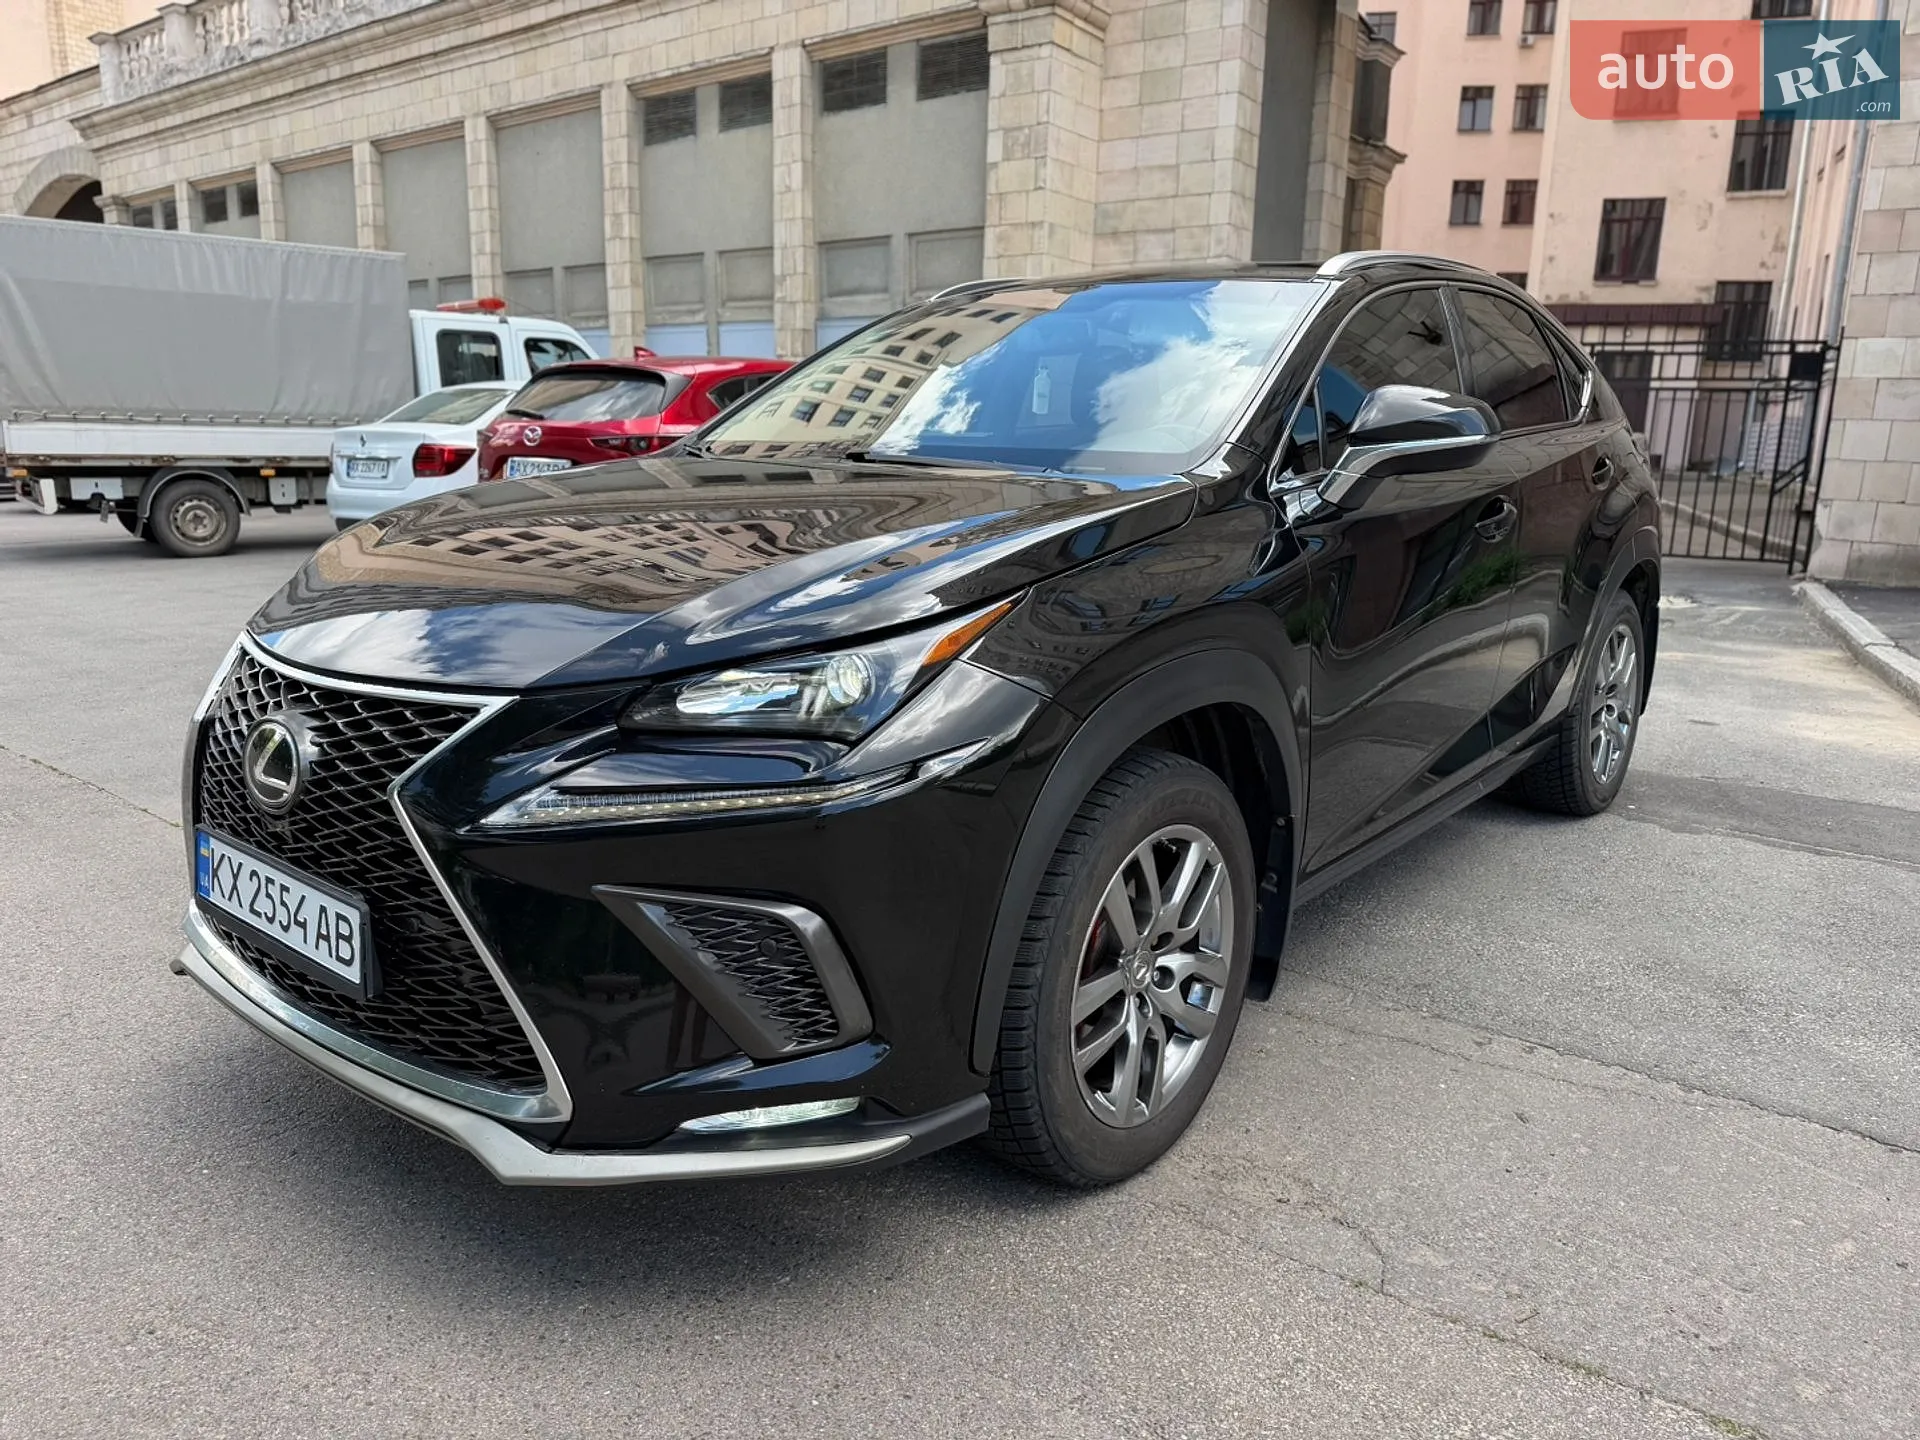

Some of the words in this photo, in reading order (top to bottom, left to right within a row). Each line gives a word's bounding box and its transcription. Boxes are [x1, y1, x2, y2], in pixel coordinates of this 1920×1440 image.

[211, 847, 243, 909] KX
[249, 869, 308, 945] 2554
[315, 904, 355, 967] AB
